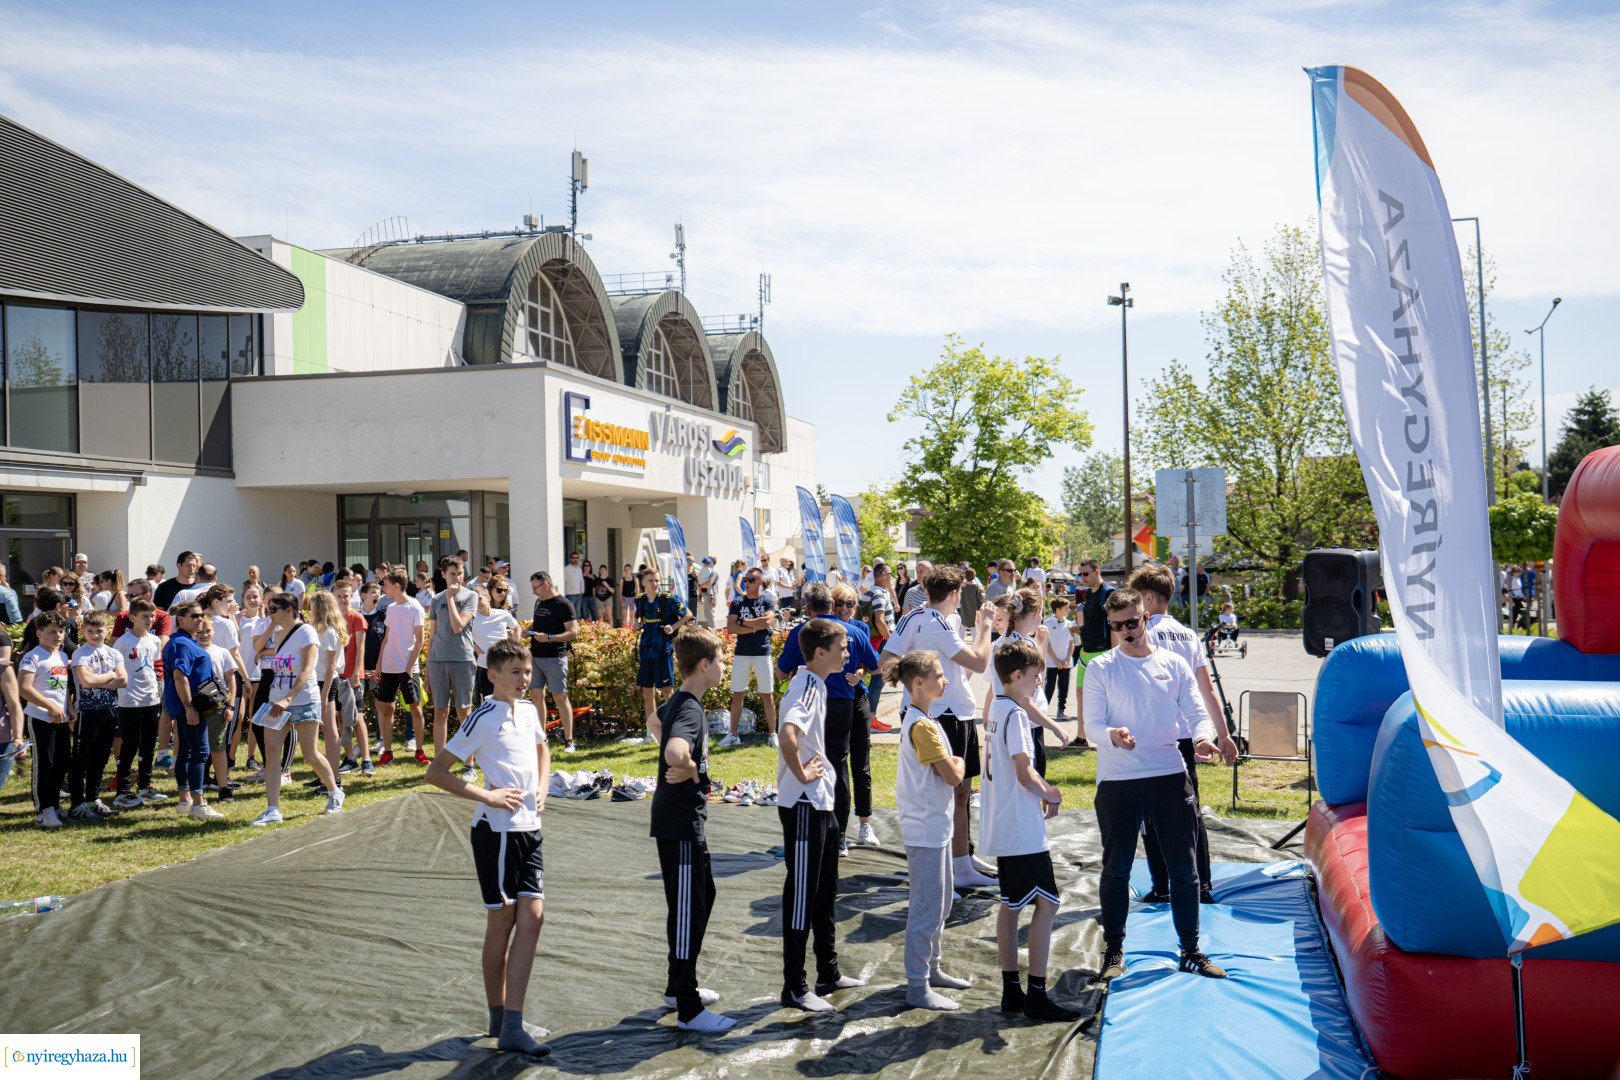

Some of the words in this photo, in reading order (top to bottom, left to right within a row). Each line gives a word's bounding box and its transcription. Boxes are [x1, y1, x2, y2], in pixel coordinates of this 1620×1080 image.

[573, 415, 650, 451] EISSMANN
[651, 405, 713, 453] VÁROSI
[591, 450, 611, 462] GROUP
[688, 457, 744, 491] USZODA
